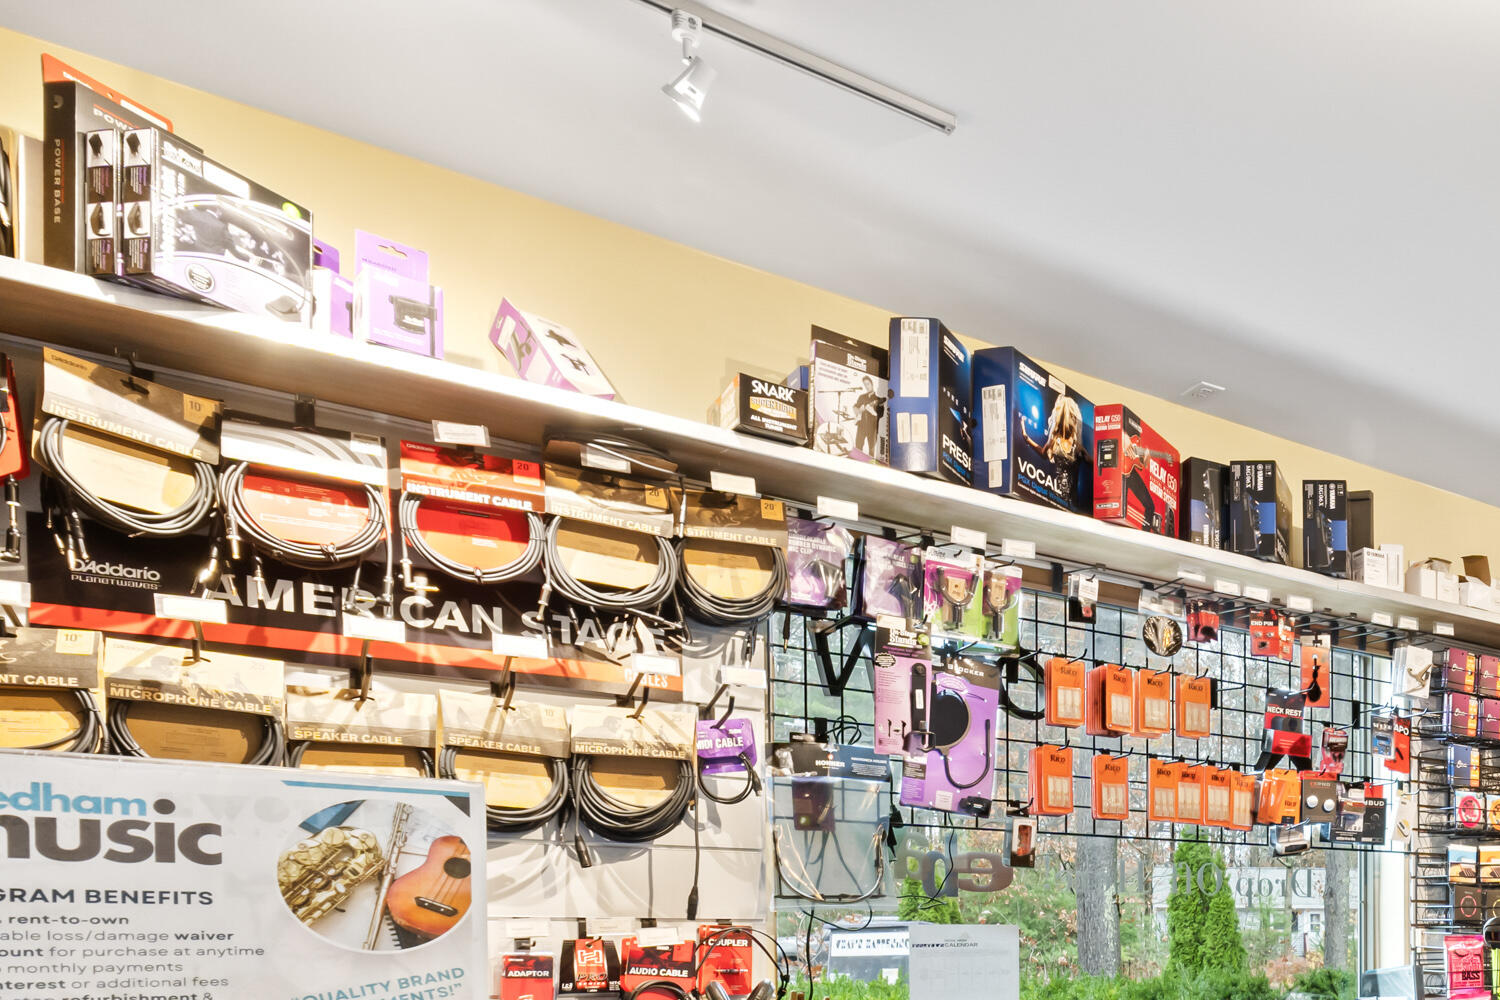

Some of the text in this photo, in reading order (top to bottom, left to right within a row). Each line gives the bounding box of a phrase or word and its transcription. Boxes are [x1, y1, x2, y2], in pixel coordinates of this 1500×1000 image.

[53, 190, 61, 224] BASE
[751, 379, 794, 402] SNARK
[750, 414, 797, 431] ALL INSTRUMENT
[1095, 415, 1110, 423] RELAY
[50, 404, 202, 461] INSTRUMENT CABLE
[1017, 457, 1063, 495] VOCAL
[1149, 459, 1167, 487] RELAY
[406, 483, 532, 511] INSTRUMENT CABLE
[551, 504, 661, 535] INSTRUMENT CABLE
[676, 524, 777, 546] ISTRUMENT CABLE
[110, 686, 271, 714] MICROPHONE CABLE
[1267, 706, 1302, 717] NECK REST
[448, 736, 541, 754] SPEAKER CABLE
[715, 736, 744, 748] CABLE
[651, 749, 686, 760] CABLE
[85, 889, 214, 906] BENEFITS
[47, 930, 234, 944] loss/damage waiver
[83, 945, 265, 959] purchase anytime
[8, 963, 183, 976] monthly payments
[508, 969, 550, 977] ADAPTOR
[629, 966, 689, 978] AUDIO CABLE
[1461, 970, 1481, 981] BASS
[96, 977, 187, 989] additional
[397, 967, 465, 990] BRAND
